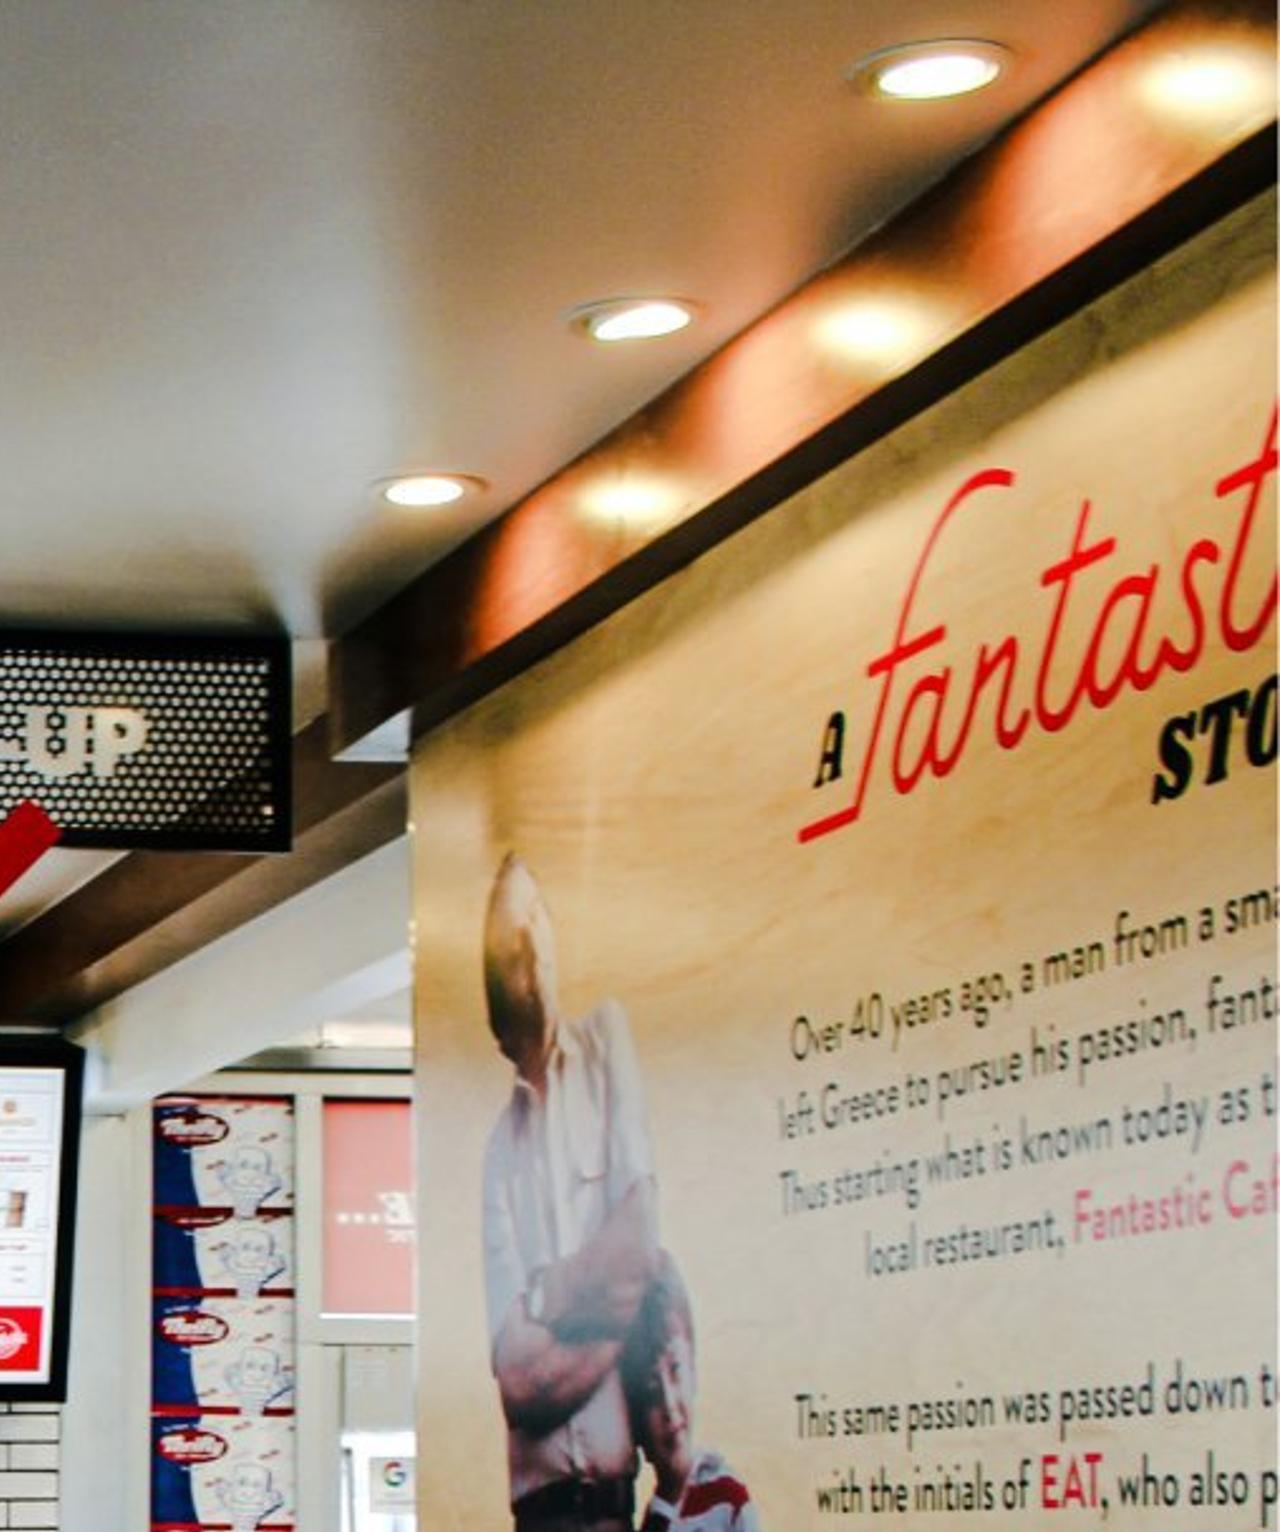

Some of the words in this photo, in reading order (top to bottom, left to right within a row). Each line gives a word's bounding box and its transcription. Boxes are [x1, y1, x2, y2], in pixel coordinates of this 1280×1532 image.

[813, 711, 845, 789] A
[790, 1016, 843, 1061] Over
[850, 993, 885, 1037] 40
[891, 988, 951, 1052] years
[959, 972, 1013, 1028] ago,
[1021, 962, 1034, 993] a
[1043, 940, 1105, 987] man
[1114, 911, 1189, 966] from
[1198, 906, 1215, 941] a
[778, 1092, 816, 1141] left
[820, 1082, 900, 1129] Greece
[906, 1074, 930, 1108] to
[938, 1050, 1022, 1122] pursue
[1031, 1024, 1070, 1078] his
[1080, 998, 1198, 1086] passion,
[1206, 975, 1278, 1034] fant
[779, 1169, 829, 1216] Thus
[833, 1149, 922, 1210] starting
[925, 1129, 986, 1183] what
[992, 1122, 1012, 1171] is
[1020, 1113, 1112, 1166] known
[1123, 1081, 1209, 1154] today
[1216, 1085, 1250, 1127] as
[865, 1220, 918, 1278] local
[924, 1209, 1066, 1267] restaurant,
[1073, 1172, 1212, 1245] Fantastic
[794, 1394, 837, 1438] This
[843, 1401, 899, 1435] same
[908, 1382, 994, 1450] passion
[1004, 1389, 1050, 1426] was
[1060, 1362, 1155, 1441] passed
[1165, 1359, 1247, 1412] down
[817, 1469, 862, 1514] with
[870, 1467, 908, 1514] the
[915, 1464, 995, 1512] initials
[1002, 1459, 1031, 1510] of
[1040, 1452, 1109, 1520] EAT,
[1118, 1454, 1179, 1506] who
[1189, 1450, 1248, 1506] also
